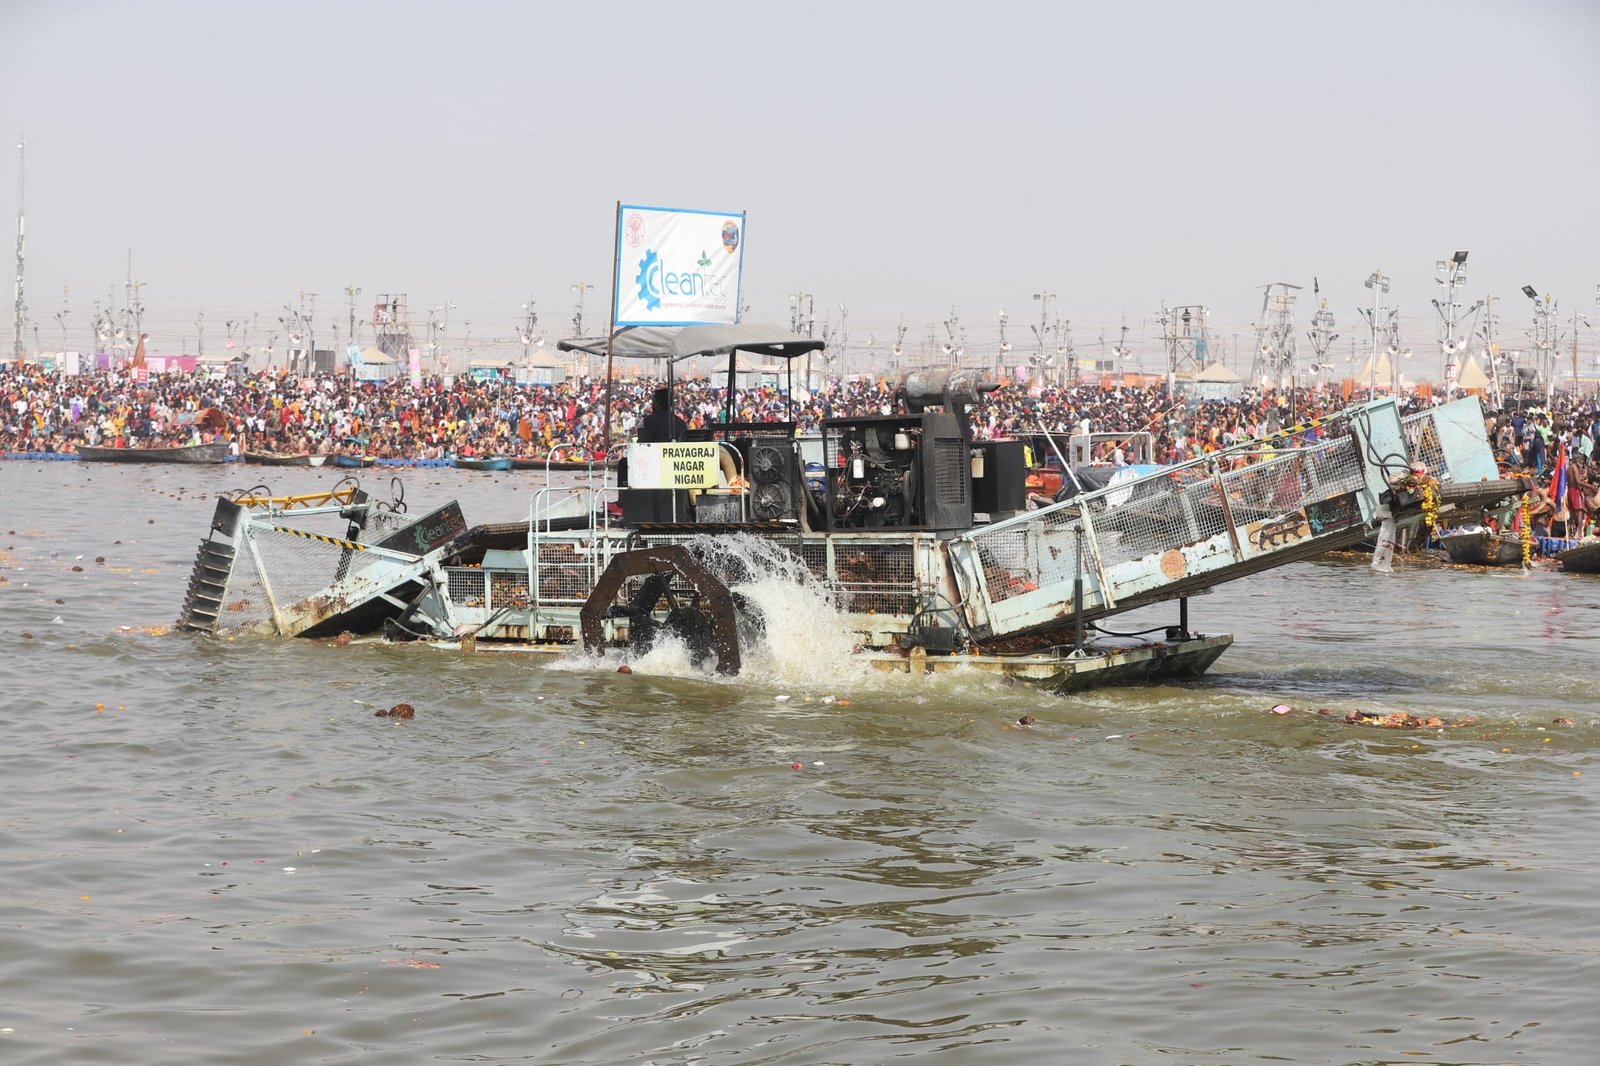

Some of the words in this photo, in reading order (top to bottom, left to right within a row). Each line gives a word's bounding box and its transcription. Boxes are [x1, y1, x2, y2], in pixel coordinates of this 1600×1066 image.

[662, 447, 715, 458] PRAYAGRAJ
[673, 461, 705, 471] NAGAR
[674, 474, 704, 485] NIGAM
